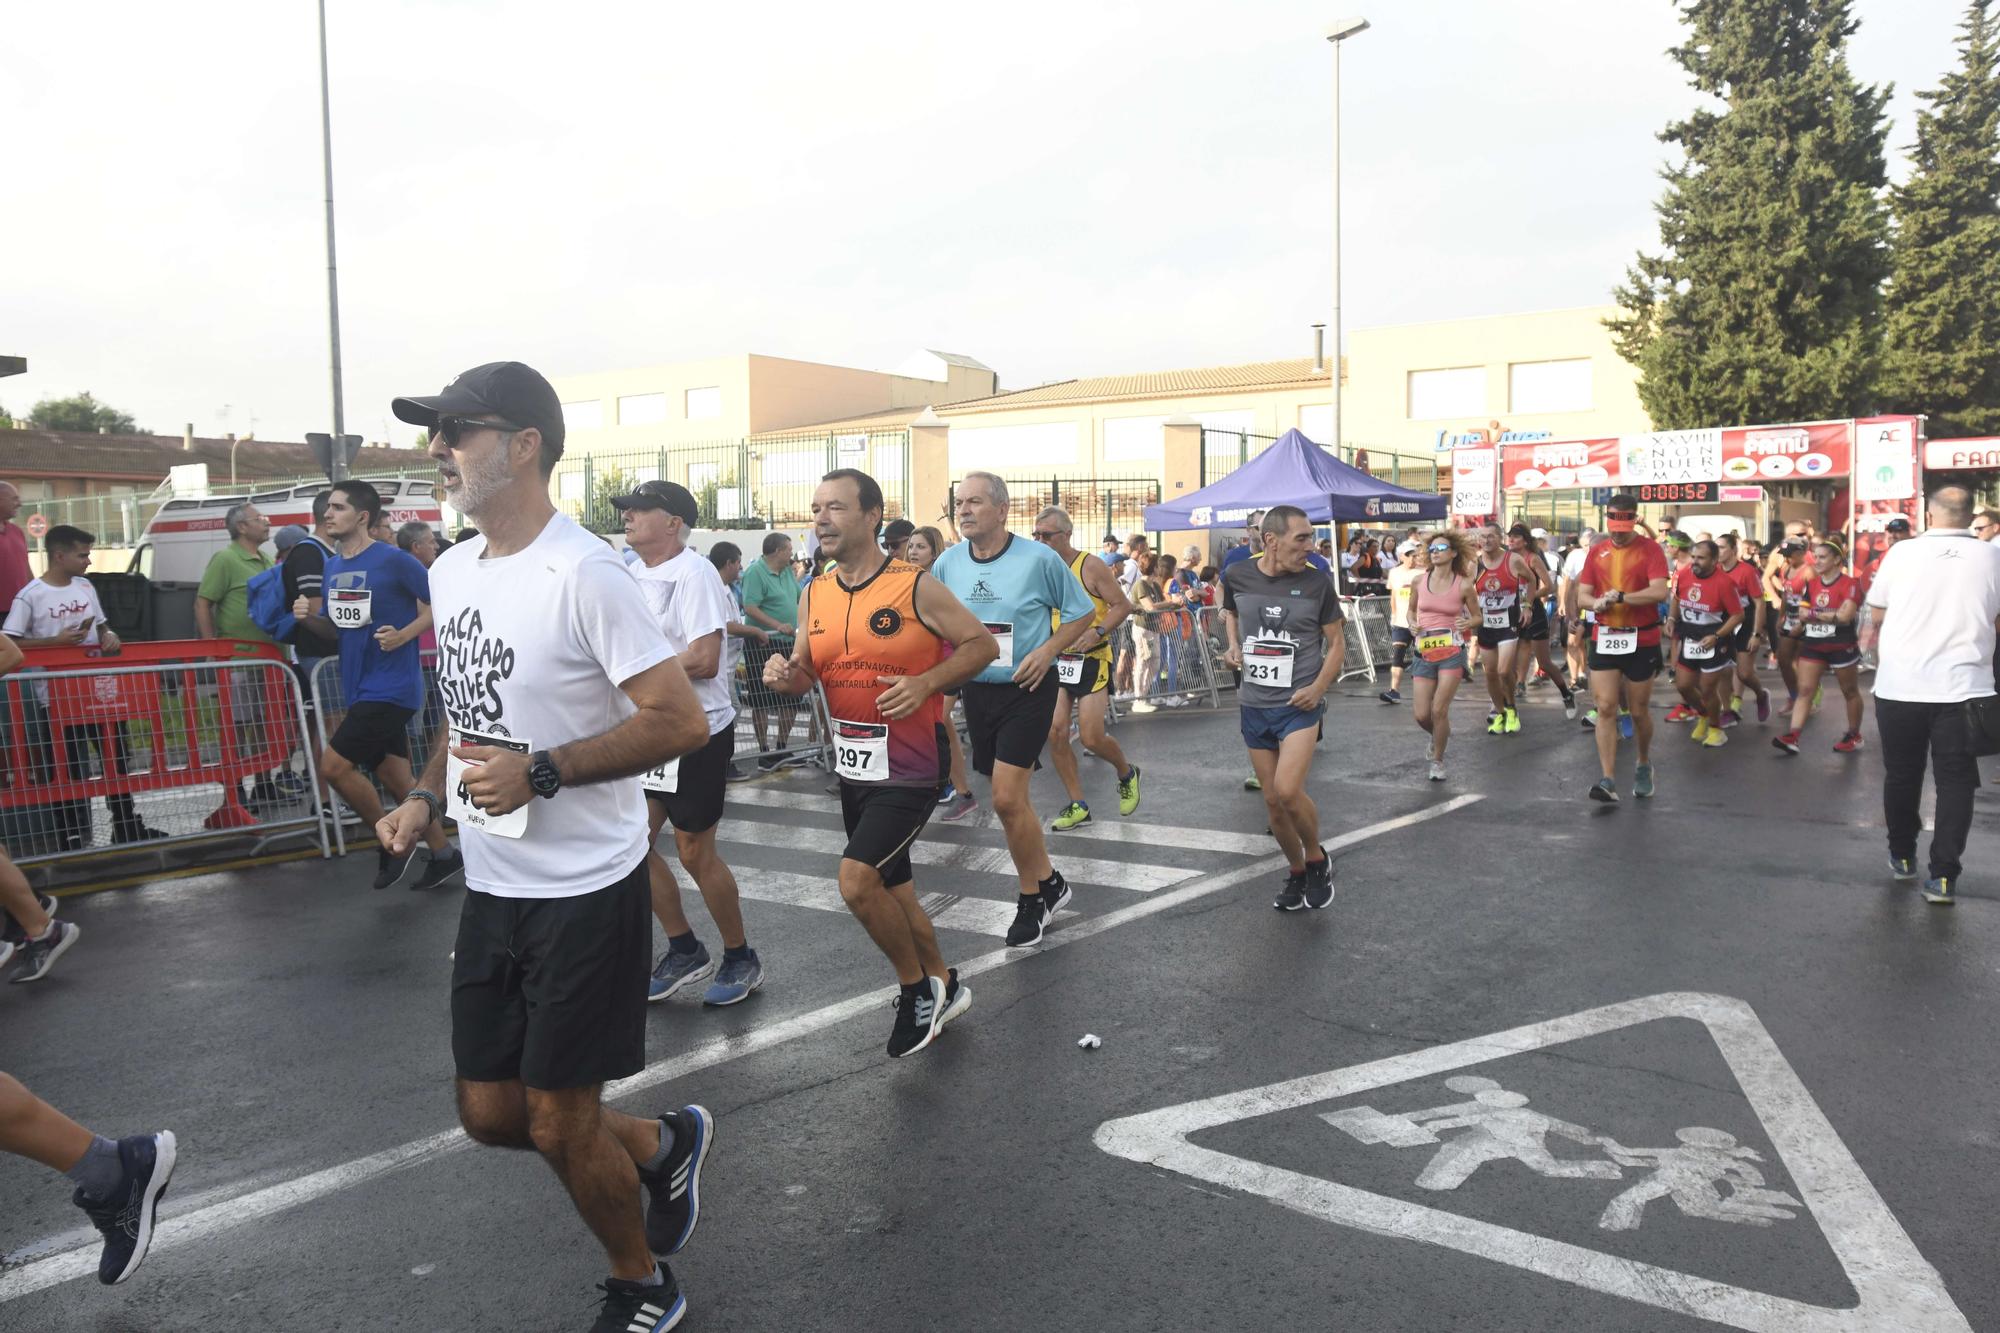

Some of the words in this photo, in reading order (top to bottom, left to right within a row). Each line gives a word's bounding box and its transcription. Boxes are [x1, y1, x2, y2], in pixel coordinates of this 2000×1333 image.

[1652, 432, 1712, 446] XXVIII
[1652, 446, 1713, 458] NON
[1652, 457, 1713, 470] DUER
[1652, 468, 1714, 481] MAS
[1640, 483, 1708, 500] 0:00:52
[335, 607, 361, 621] 308
[1424, 640, 1446, 649] 815
[1605, 639, 1629, 649] 289
[471, 635, 515, 680] LADO
[854, 661, 908, 676] BENAVENTE
[1249, 664, 1280, 680] 231
[838, 746, 873, 770] 297
